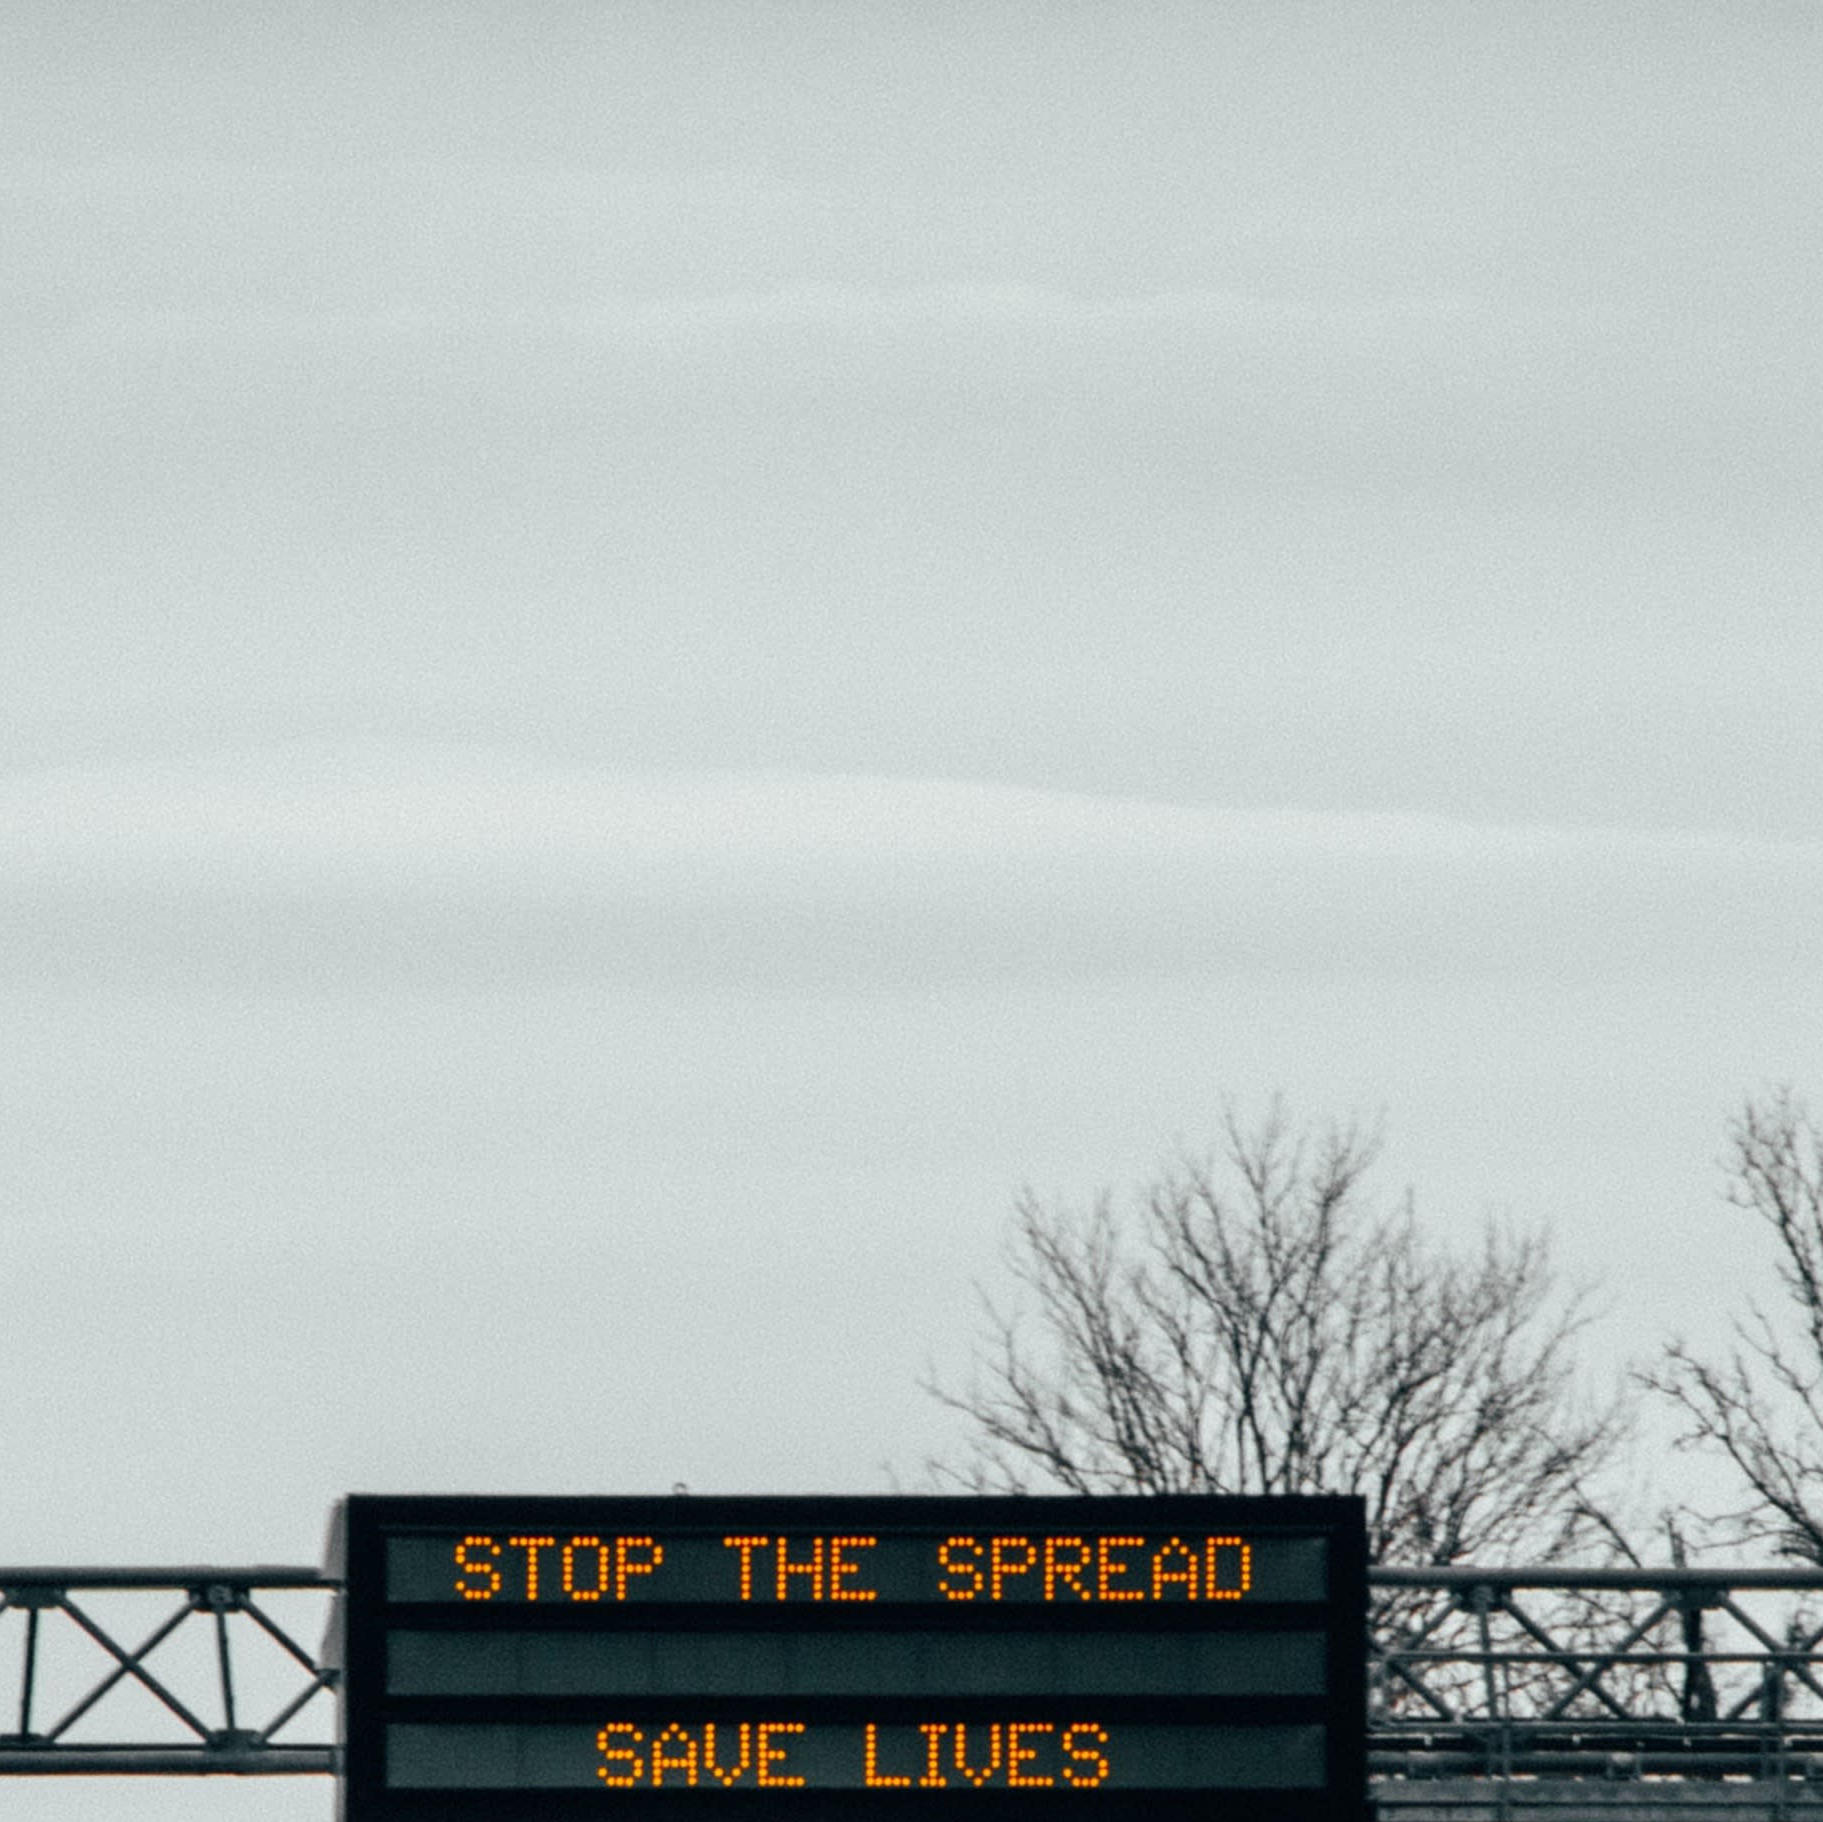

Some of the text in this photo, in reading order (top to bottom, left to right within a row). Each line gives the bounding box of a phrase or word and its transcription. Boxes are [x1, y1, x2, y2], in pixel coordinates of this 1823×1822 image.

[455, 1536, 1251, 1601] STOP THE SPREAD
[596, 1722, 1109, 1787] SAVE LIVES
